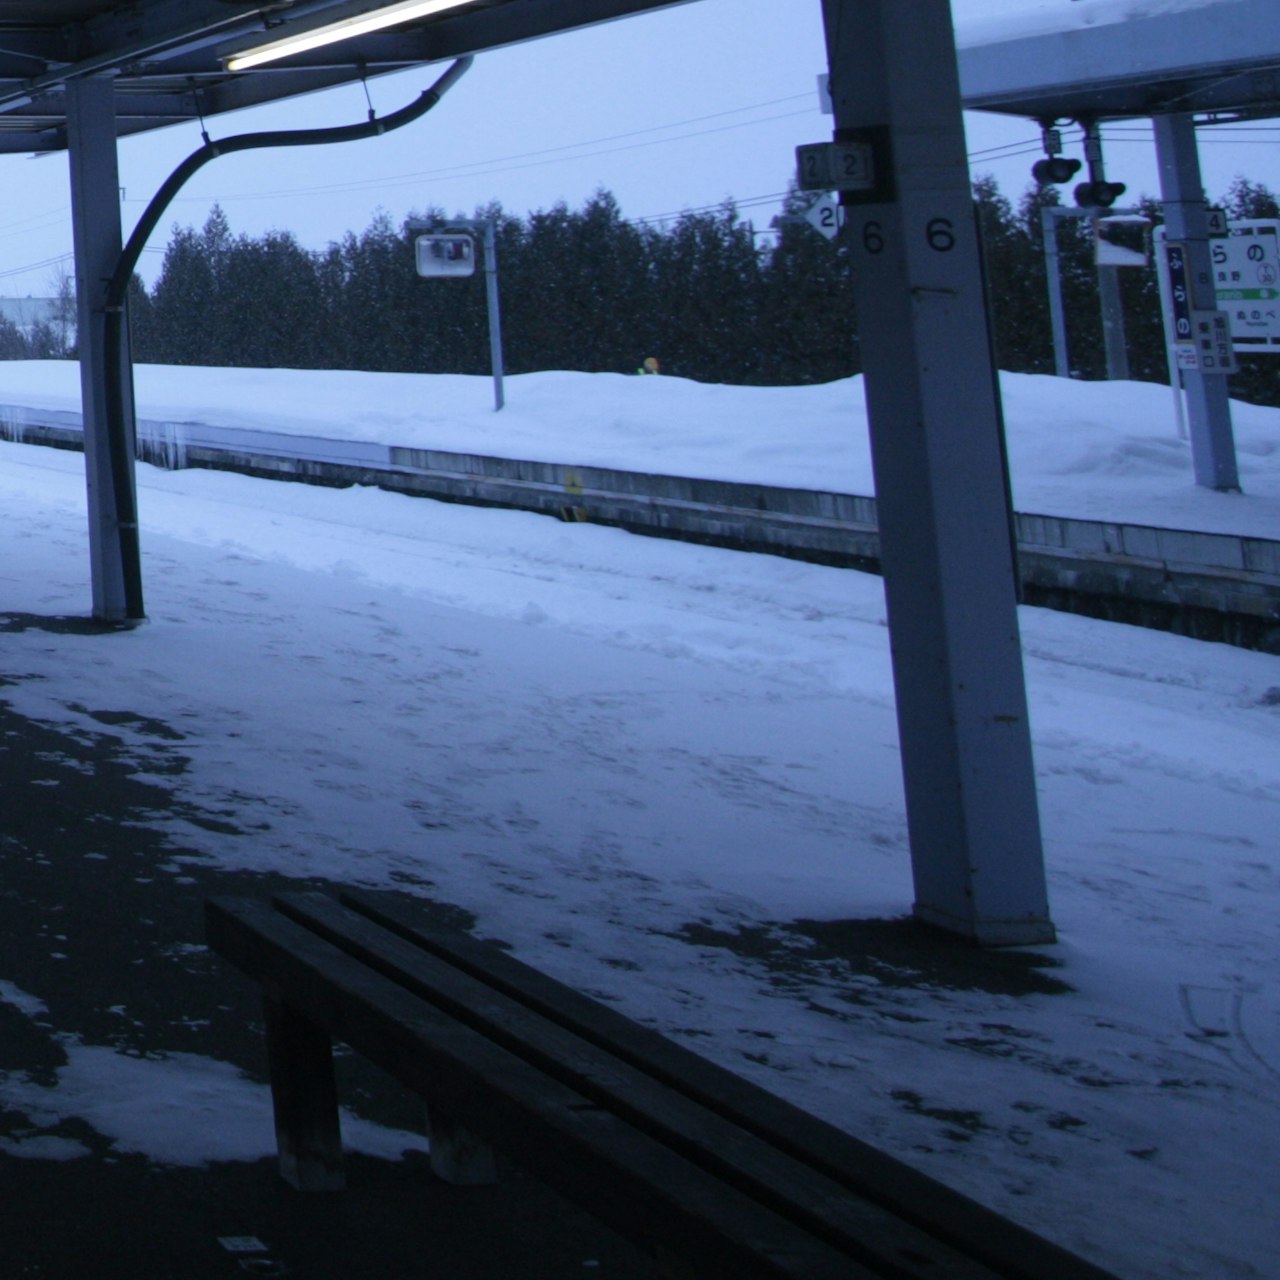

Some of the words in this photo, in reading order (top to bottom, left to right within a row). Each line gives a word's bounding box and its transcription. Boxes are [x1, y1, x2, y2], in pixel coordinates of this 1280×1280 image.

[820, 207, 835, 227] 2
[863, 221, 884, 254] 6
[926, 218, 955, 252] 6
